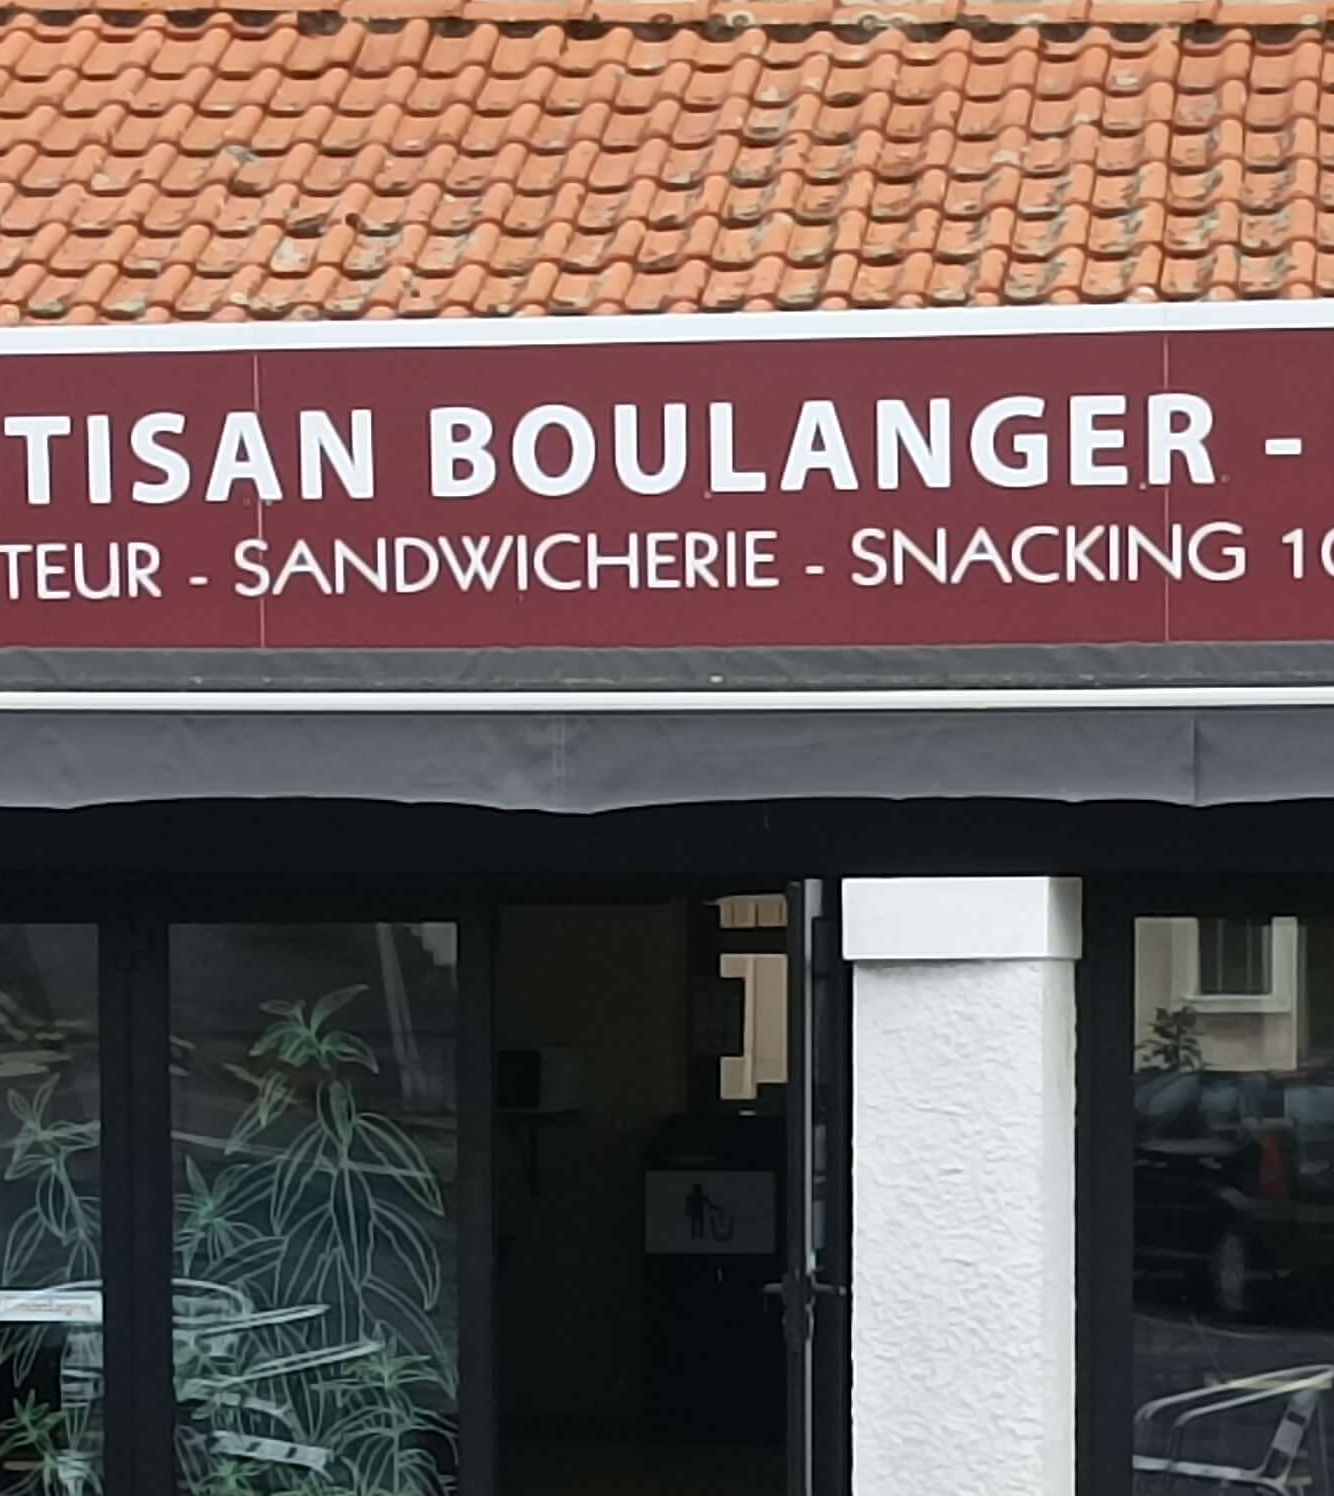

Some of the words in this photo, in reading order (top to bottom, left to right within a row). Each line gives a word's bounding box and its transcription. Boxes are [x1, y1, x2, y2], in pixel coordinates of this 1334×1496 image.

[430, 393, 1217, 498] BOULANGER
[1265, 438, 1304, 455] -
[234, 530, 782, 598] SANDWICHERIE
[851, 521, 1248, 587] SNACKING
